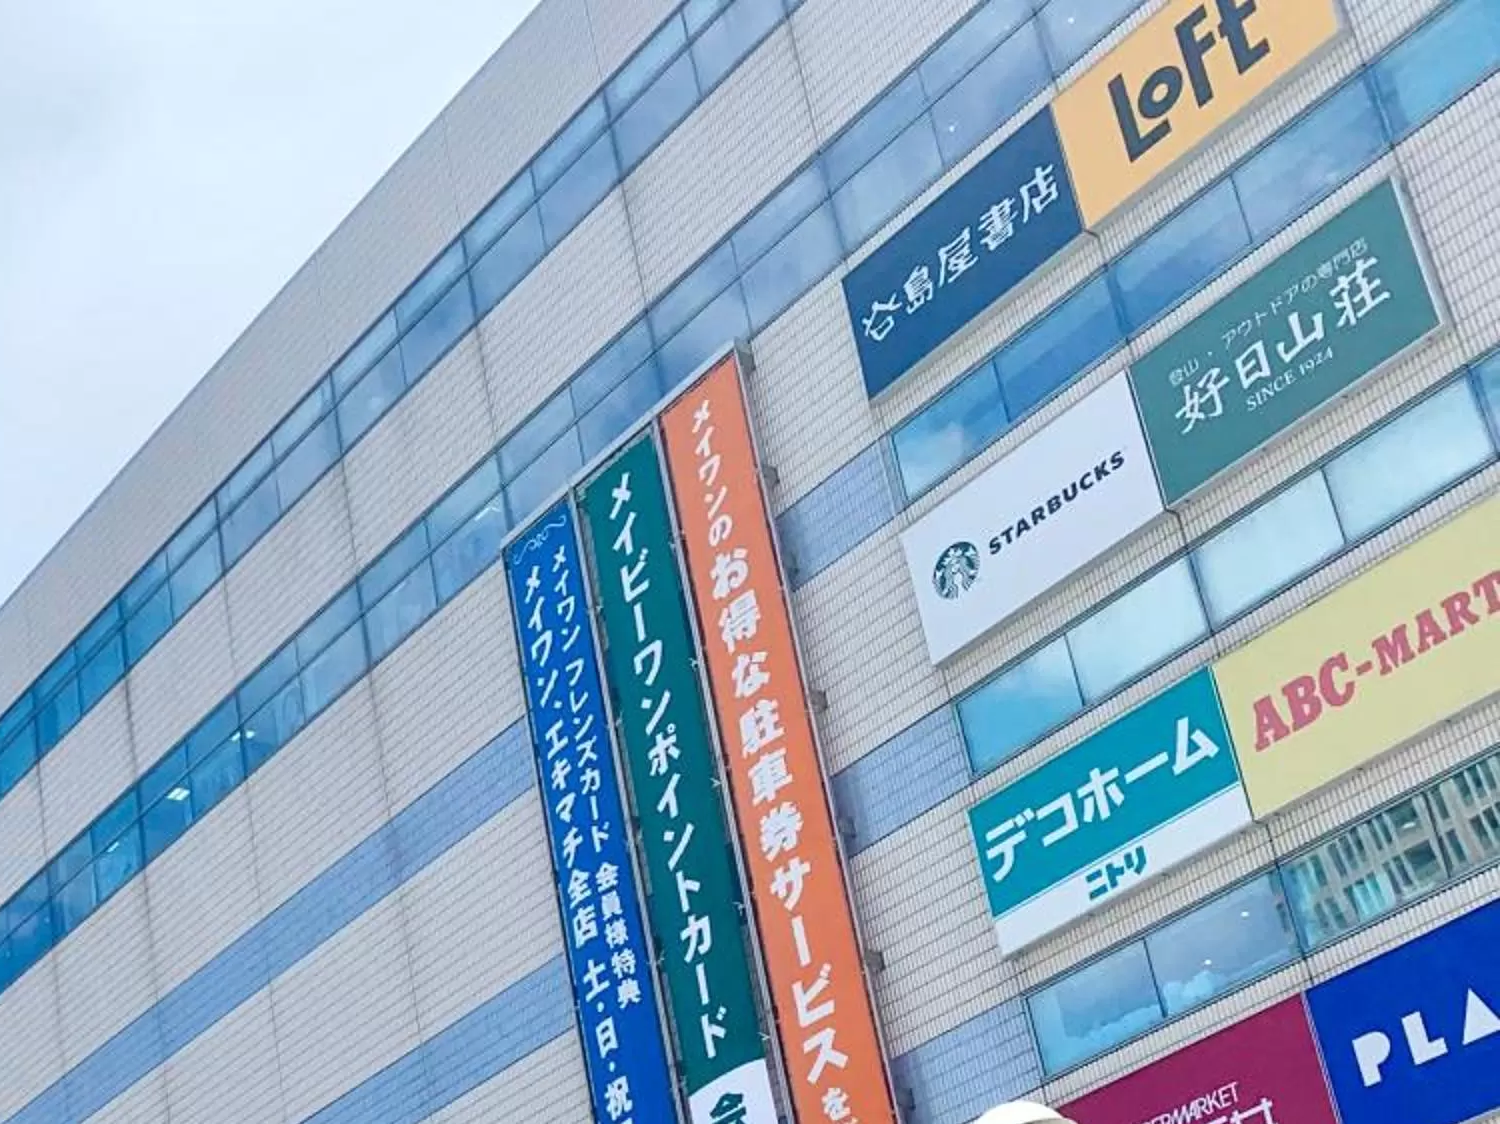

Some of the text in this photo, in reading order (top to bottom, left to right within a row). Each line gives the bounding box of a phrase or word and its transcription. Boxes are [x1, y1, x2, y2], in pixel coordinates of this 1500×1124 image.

[861, 160, 1060, 342] 谷島屋書店
[1175, 257, 1391, 434] 好日山荘
[1247, 347, 1334, 411] SINCE 1924
[988, 451, 1125, 555] STARBUCKS
[1254, 571, 1500, 752] ABC-MART
[609, 472, 729, 1059] メイビーワンポイントカード
[985, 716, 1220, 882] デコホーム
[595, 862, 642, 1009] 会員様特典
[1084, 845, 1148, 901] ニトリ
